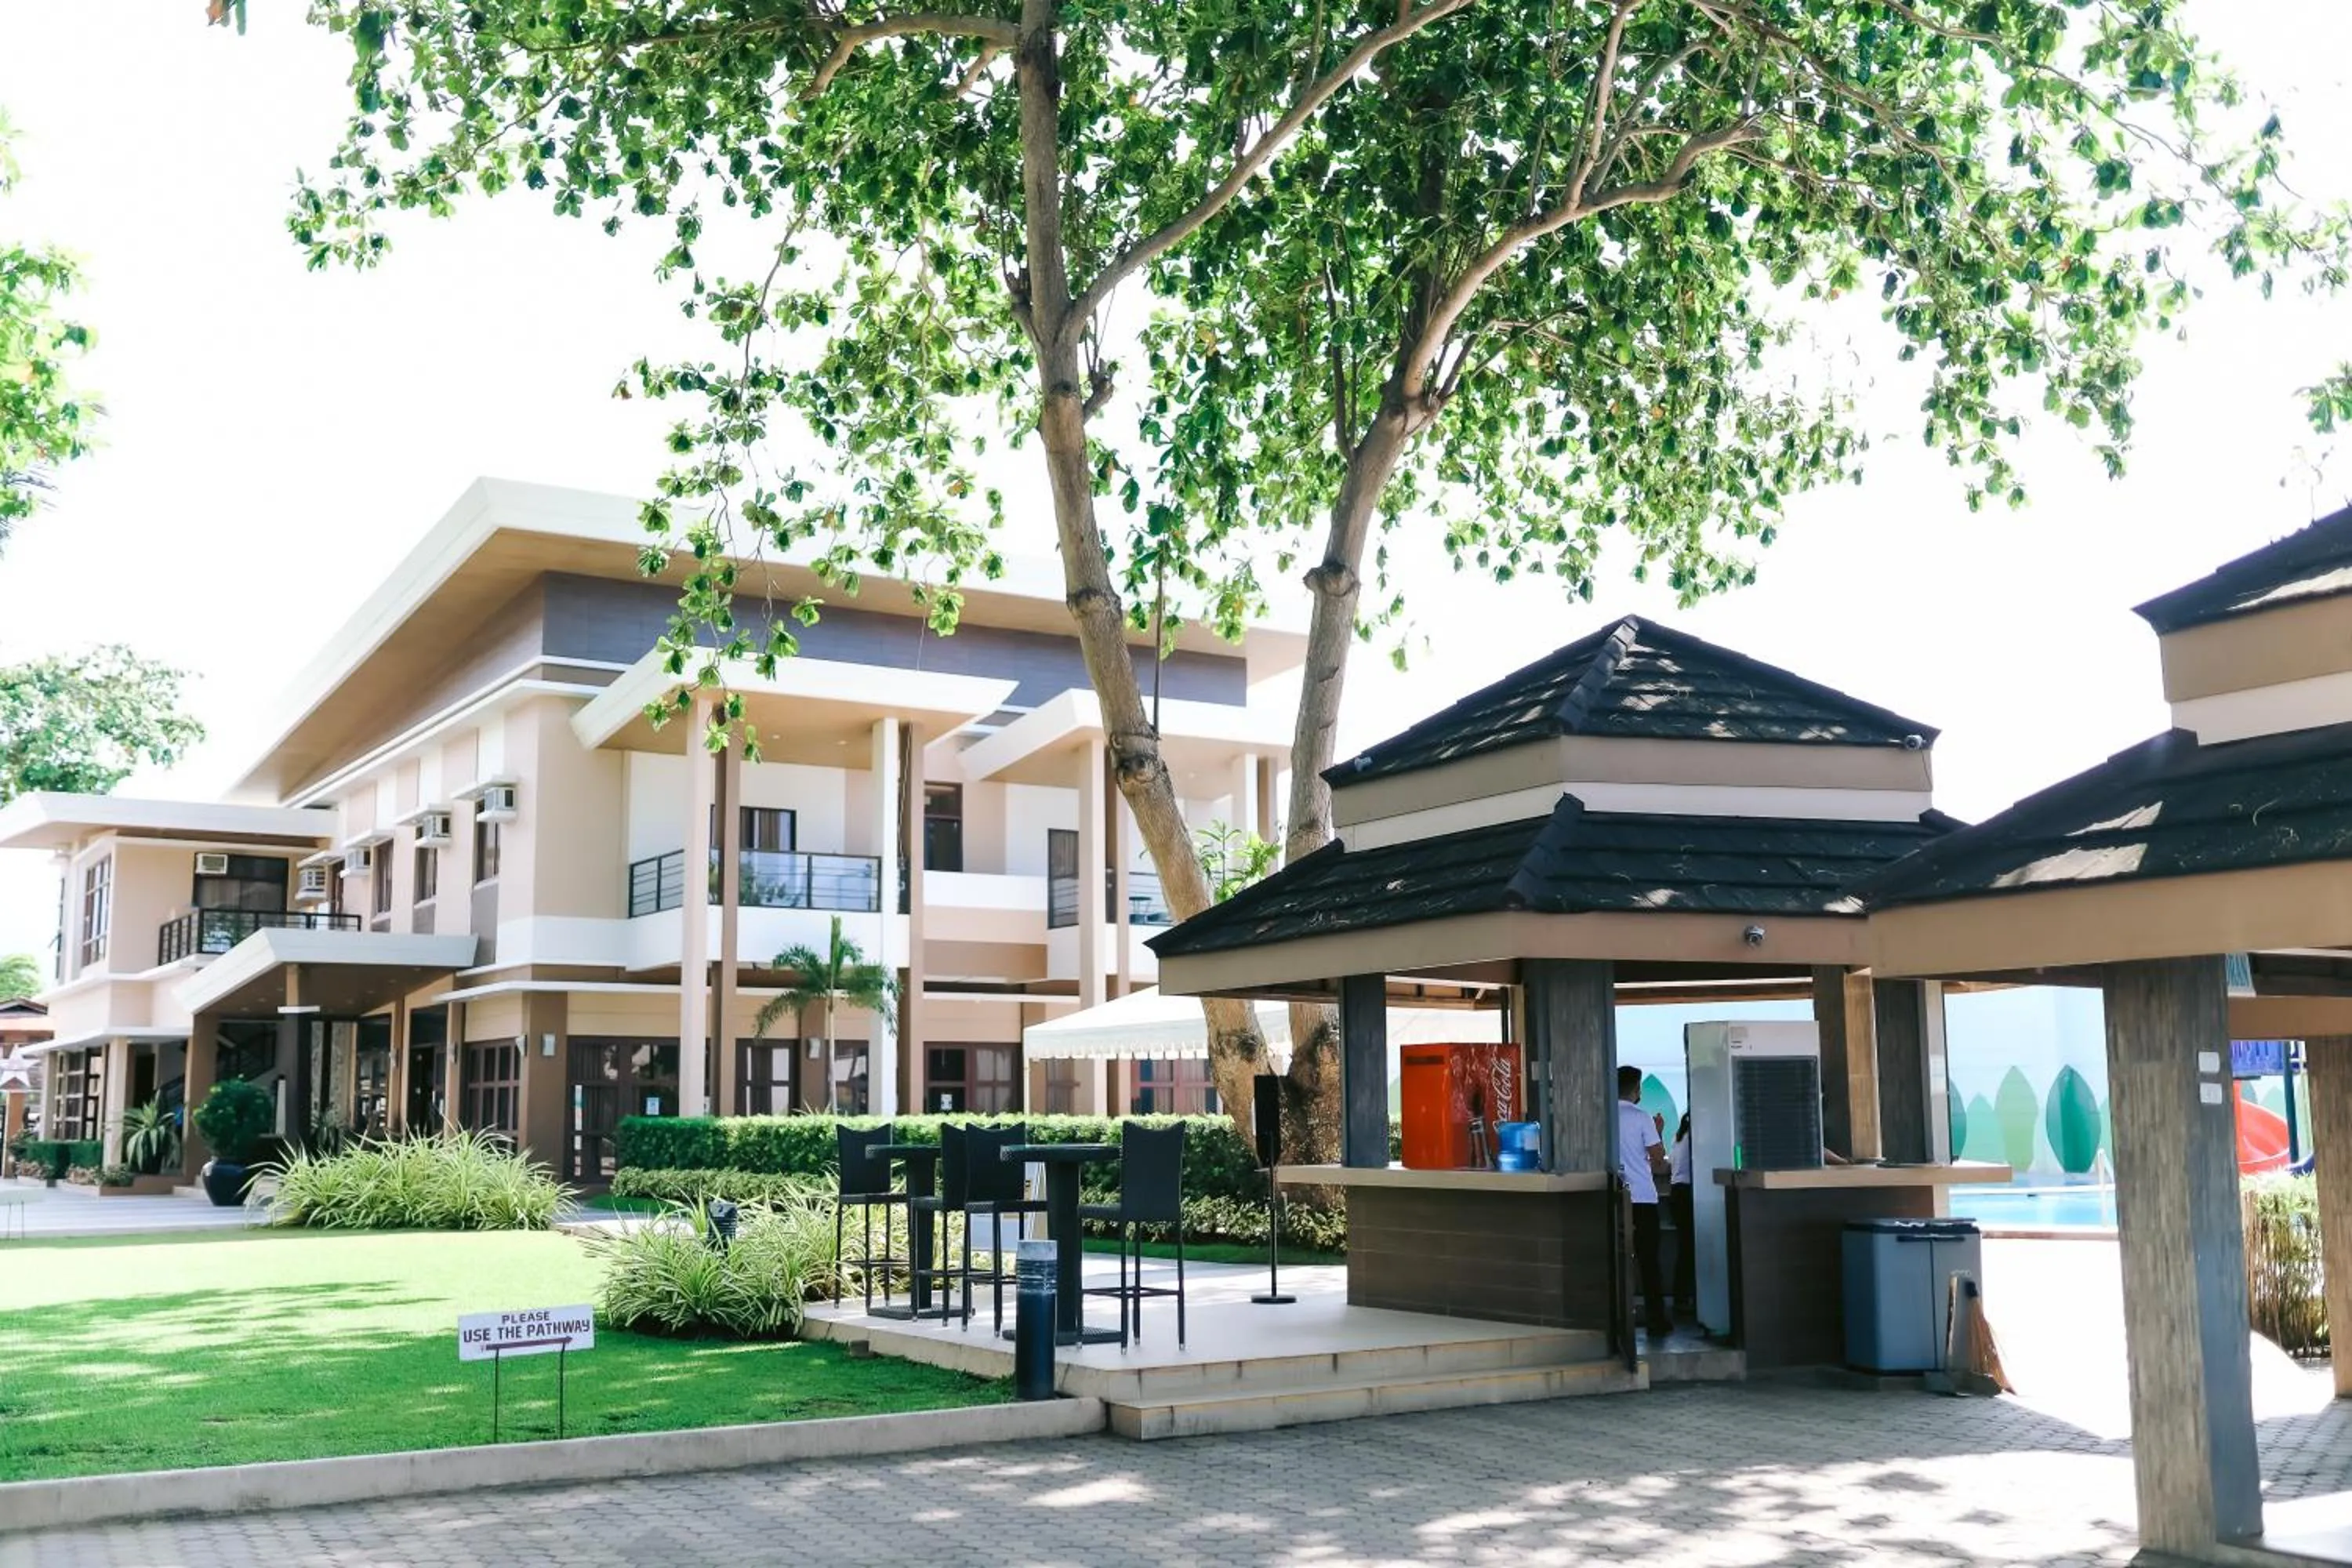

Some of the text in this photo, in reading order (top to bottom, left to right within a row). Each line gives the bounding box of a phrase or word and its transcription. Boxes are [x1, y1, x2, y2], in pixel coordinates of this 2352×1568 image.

[502, 1311, 550, 1324] PLEASE
[463, 1319, 591, 1343] USE THE PATHWAY
